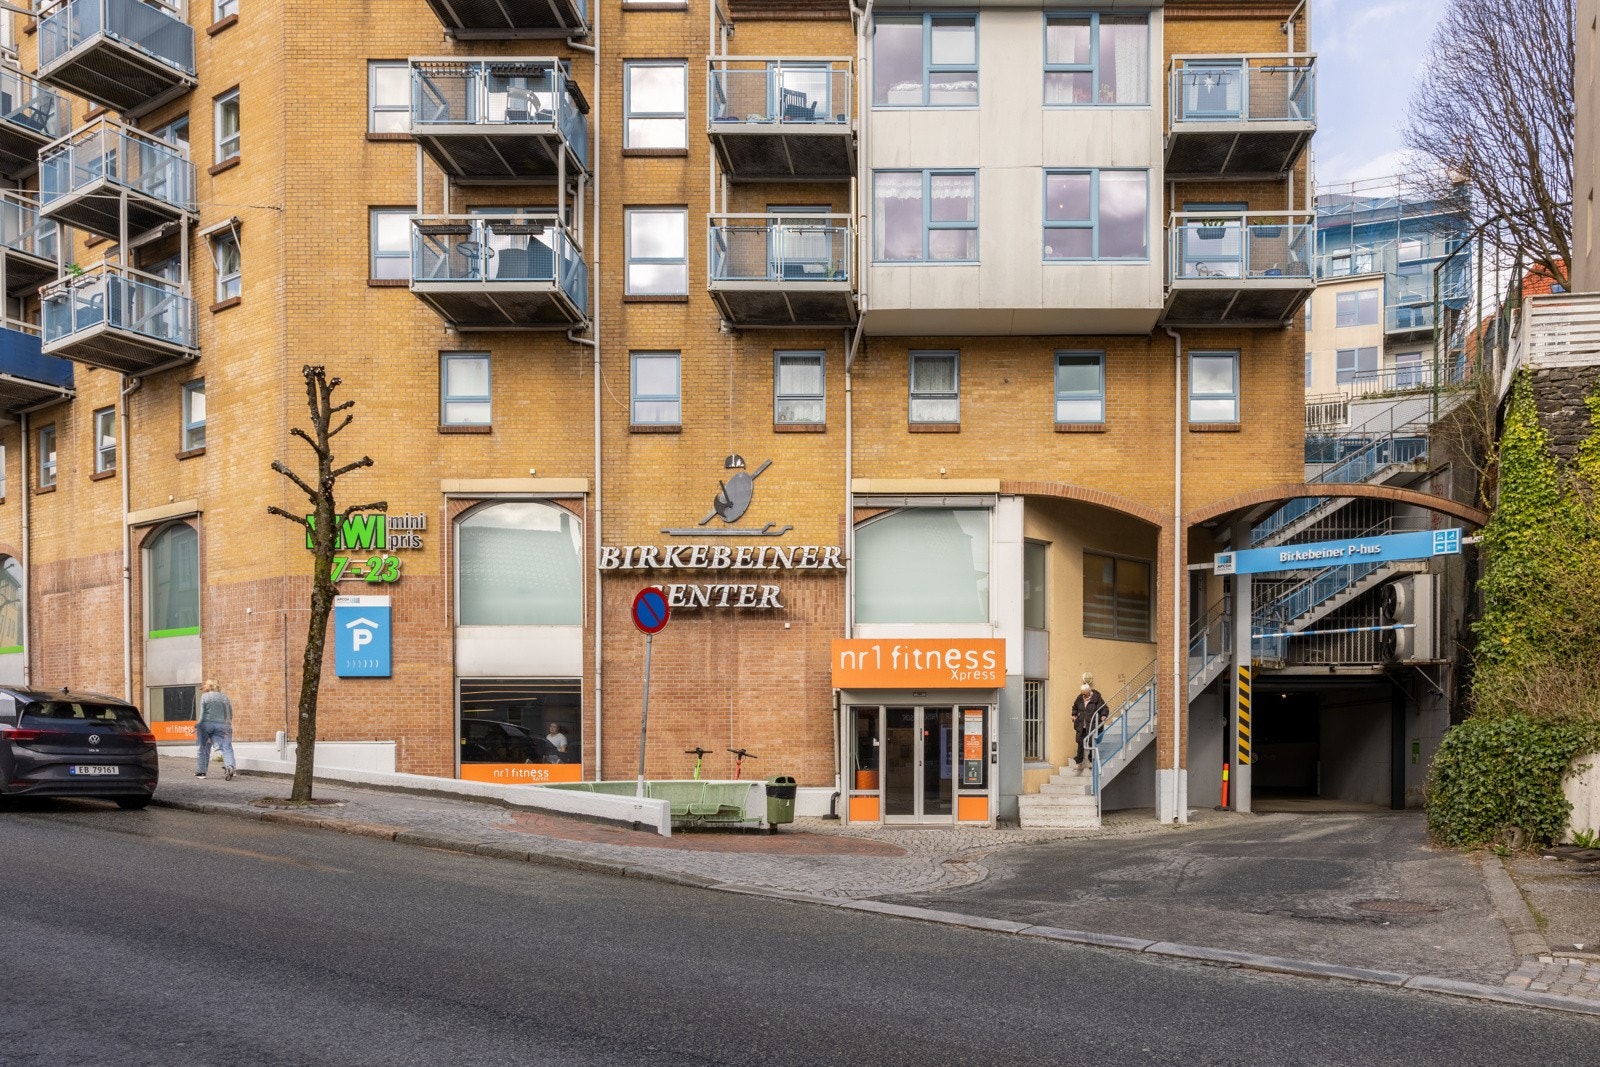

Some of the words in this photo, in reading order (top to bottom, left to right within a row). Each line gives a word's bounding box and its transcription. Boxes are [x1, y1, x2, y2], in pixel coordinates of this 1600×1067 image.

[390, 512, 426, 529] mini
[390, 531, 422, 550] pris
[598, 544, 847, 570] BIRKEBEINER
[1279, 547, 1345, 563] Birkebeiner
[1348, 543, 1382, 556] P-hus
[353, 628, 373, 652] P
[840, 644, 881, 670] nr1
[891, 645, 996, 670] fitness
[950, 668, 996, 682] Xpress
[79, 766, 90, 774] EB
[92, 766, 116, 774] 79161
[511, 768, 549, 778] fitness
